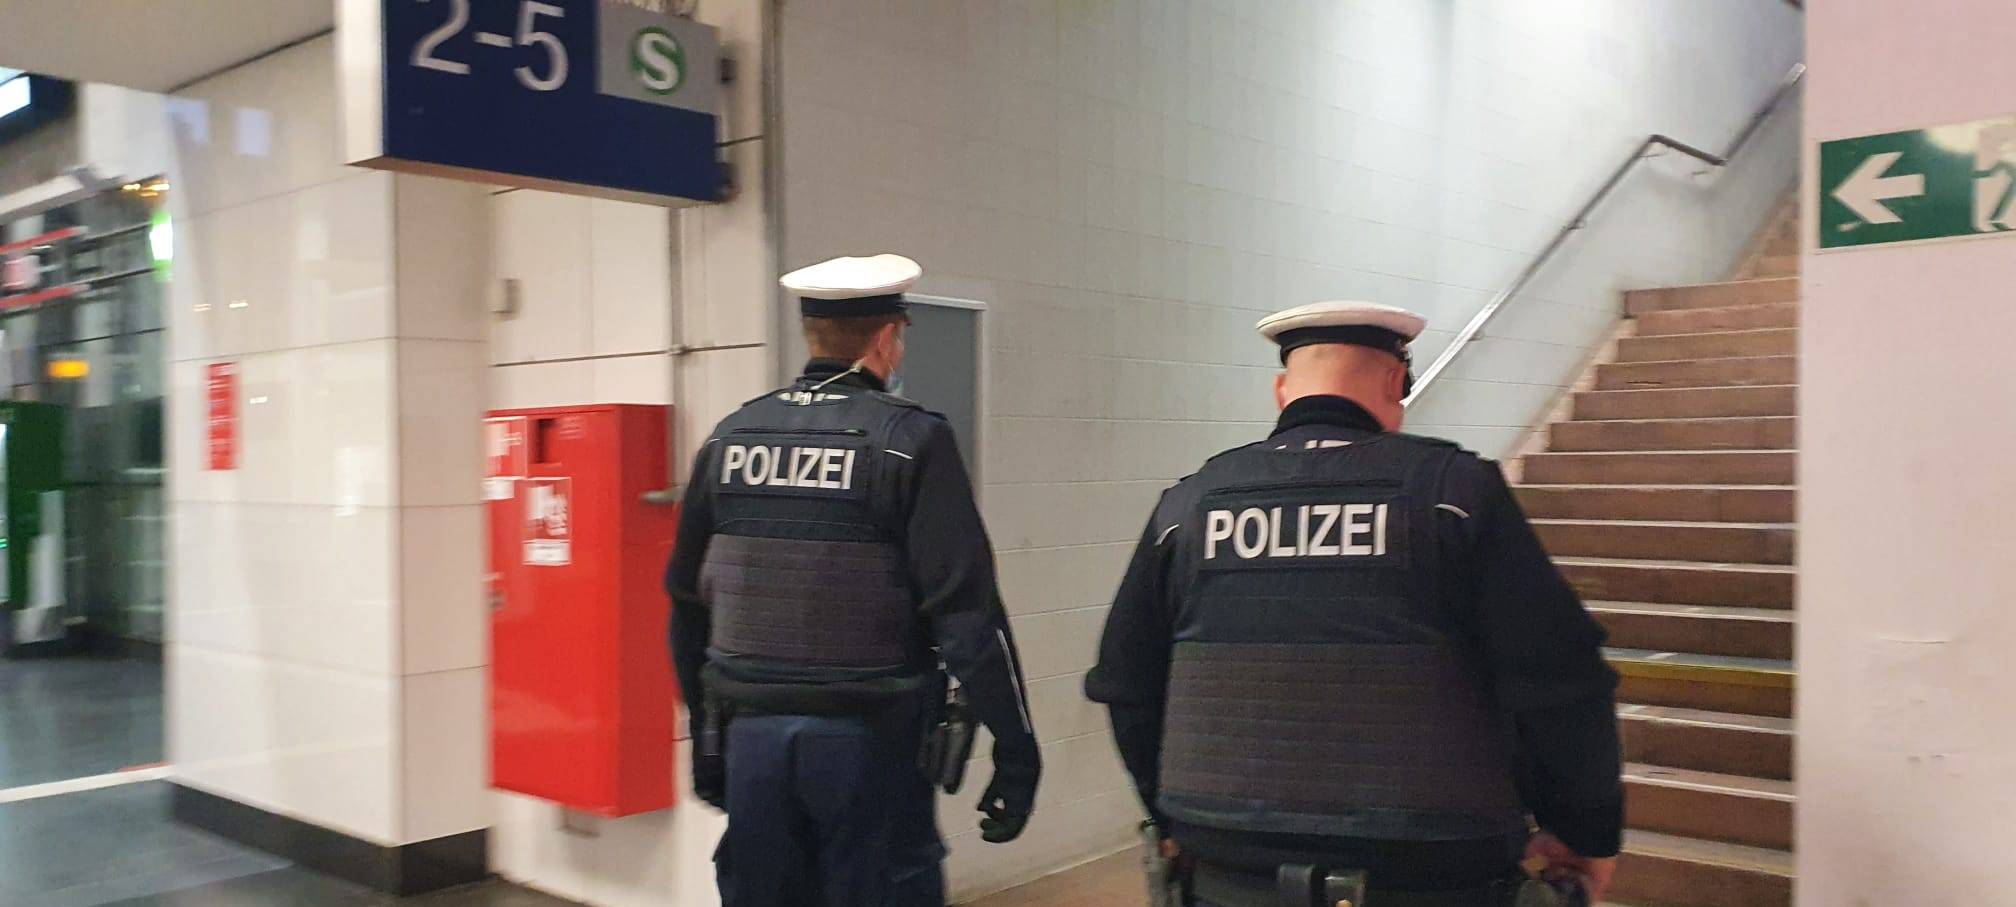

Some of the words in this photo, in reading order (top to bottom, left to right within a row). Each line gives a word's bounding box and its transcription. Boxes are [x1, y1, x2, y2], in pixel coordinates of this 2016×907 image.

[410, 0, 569, 91] 2-5
[634, 32, 681, 91] S
[720, 445, 856, 490] POLIZEI
[1204, 503, 1388, 560] POLIZEI
